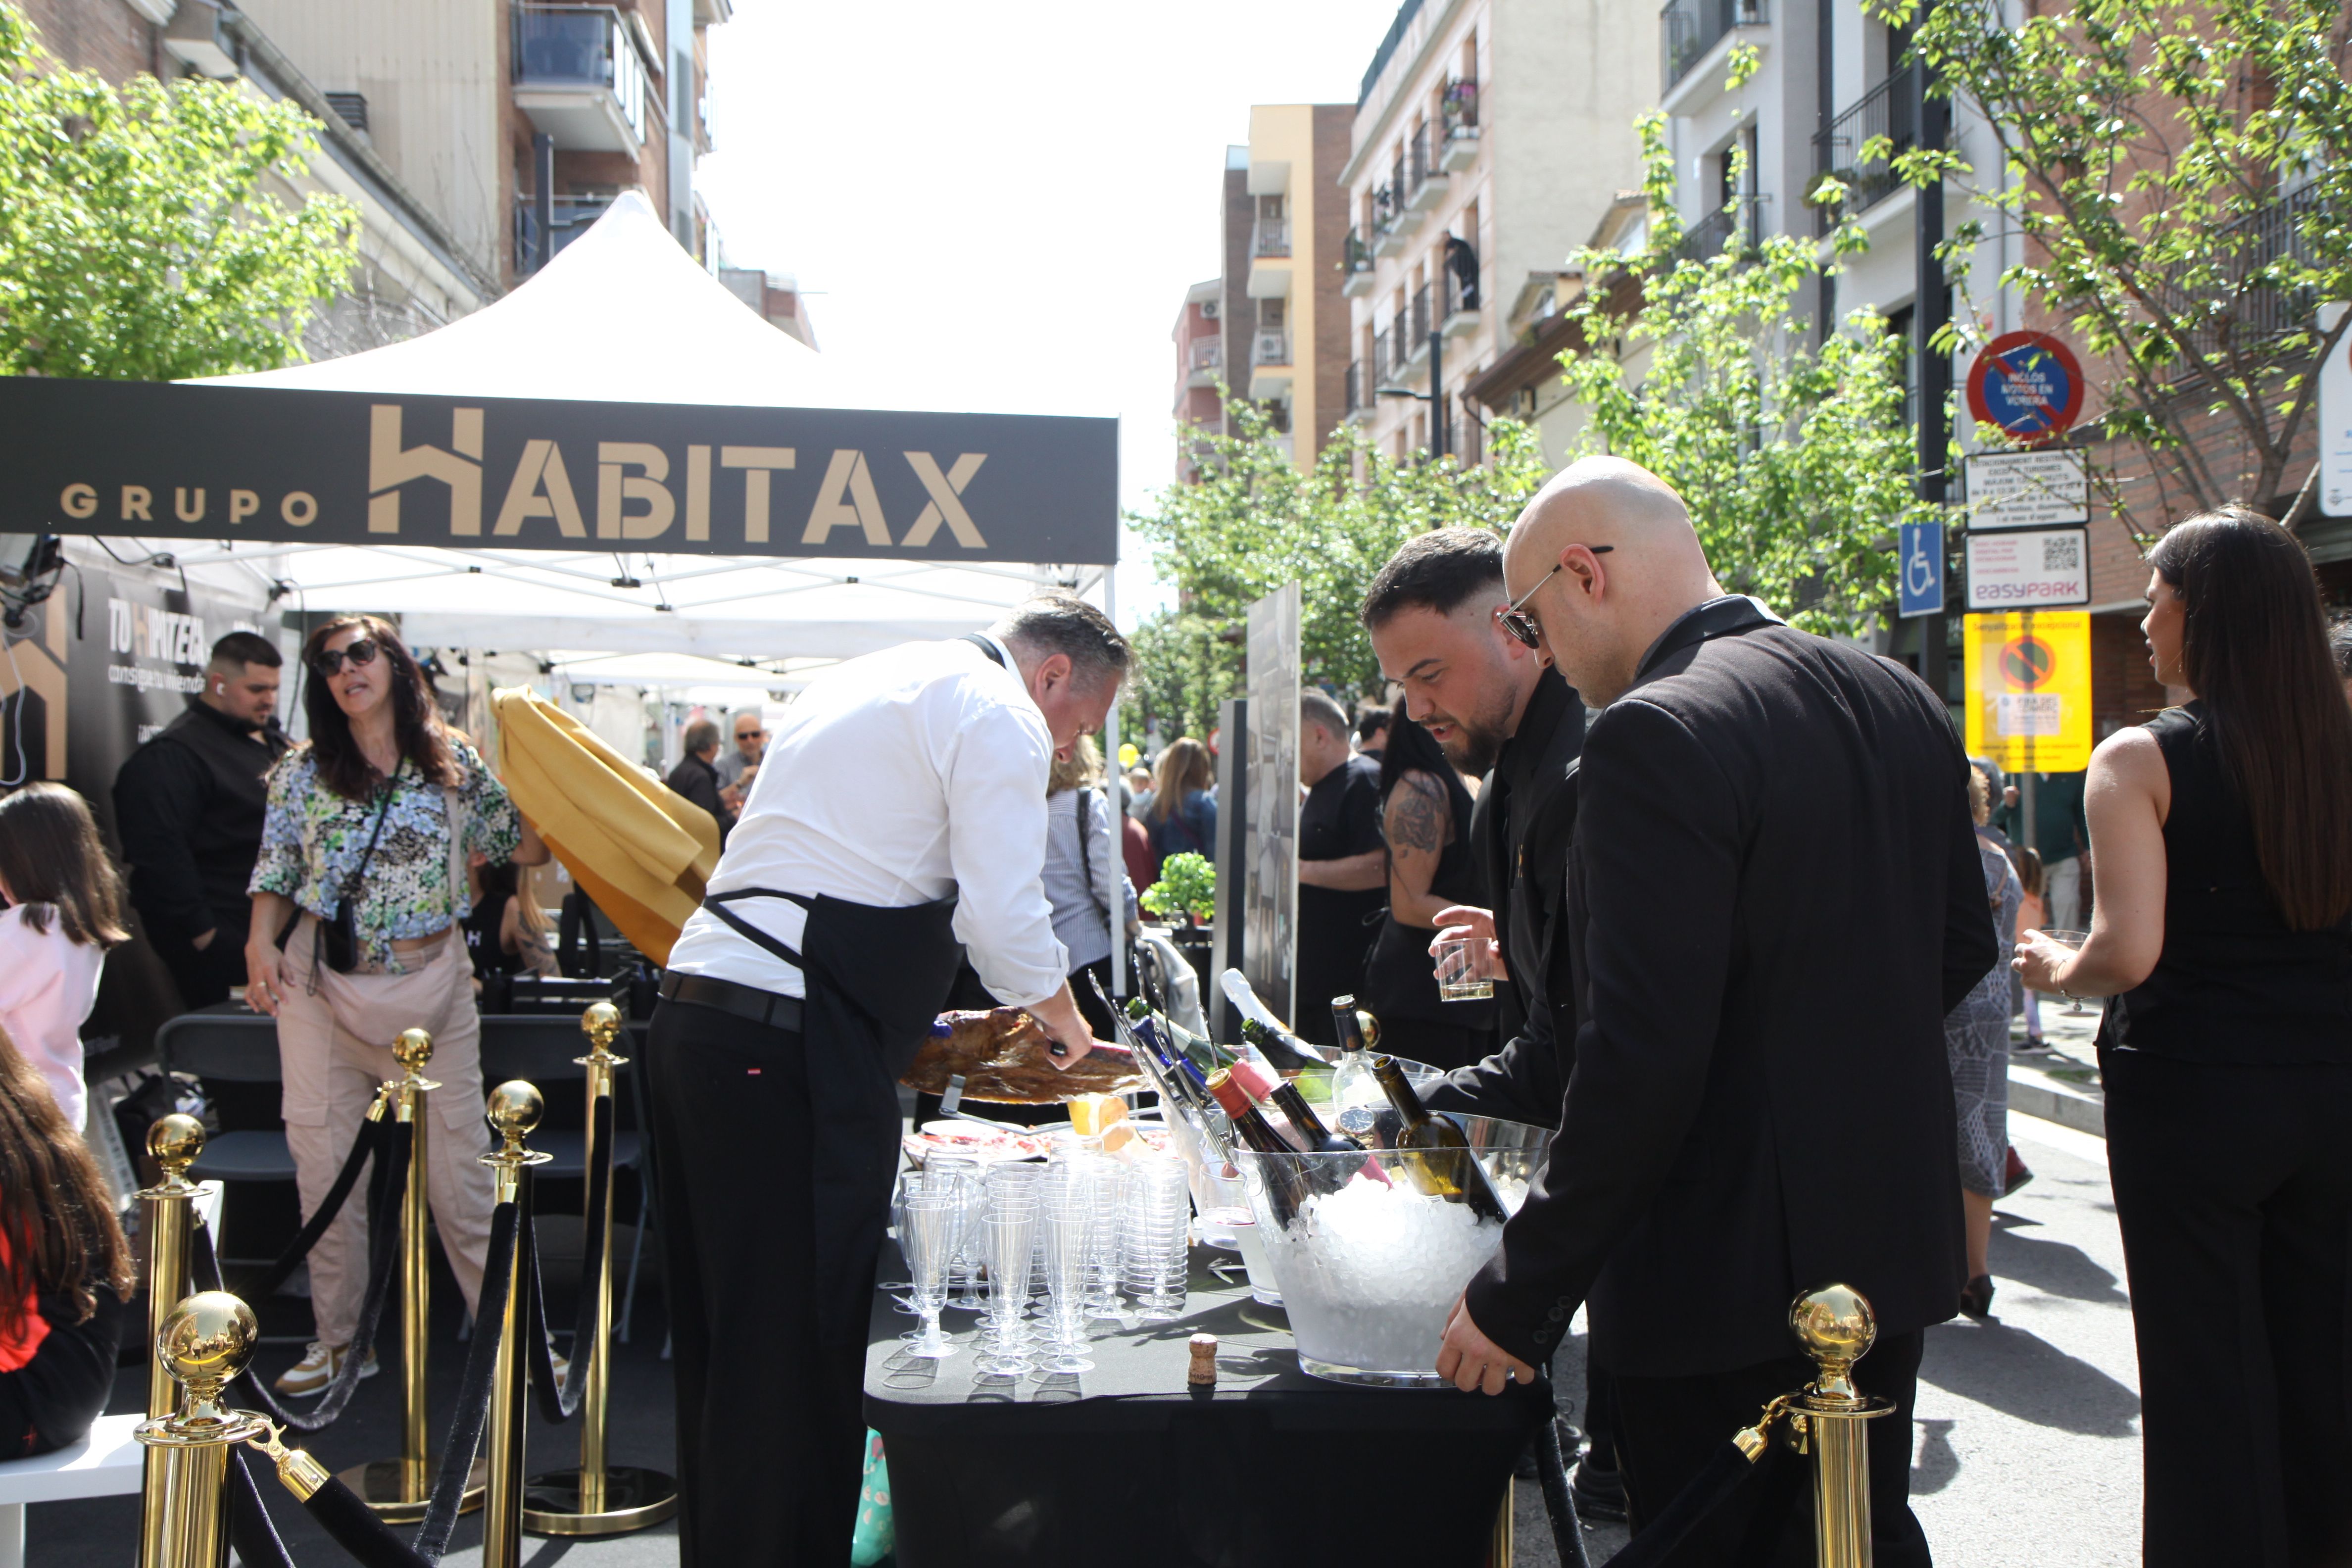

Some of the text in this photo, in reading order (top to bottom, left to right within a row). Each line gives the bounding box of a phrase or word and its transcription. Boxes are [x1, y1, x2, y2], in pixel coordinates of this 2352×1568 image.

[2001, 384, 2054, 395] MOTOS EN
[2005, 395, 2049, 406] VORERA
[60, 404, 989, 549] GRUPO HABITAX
